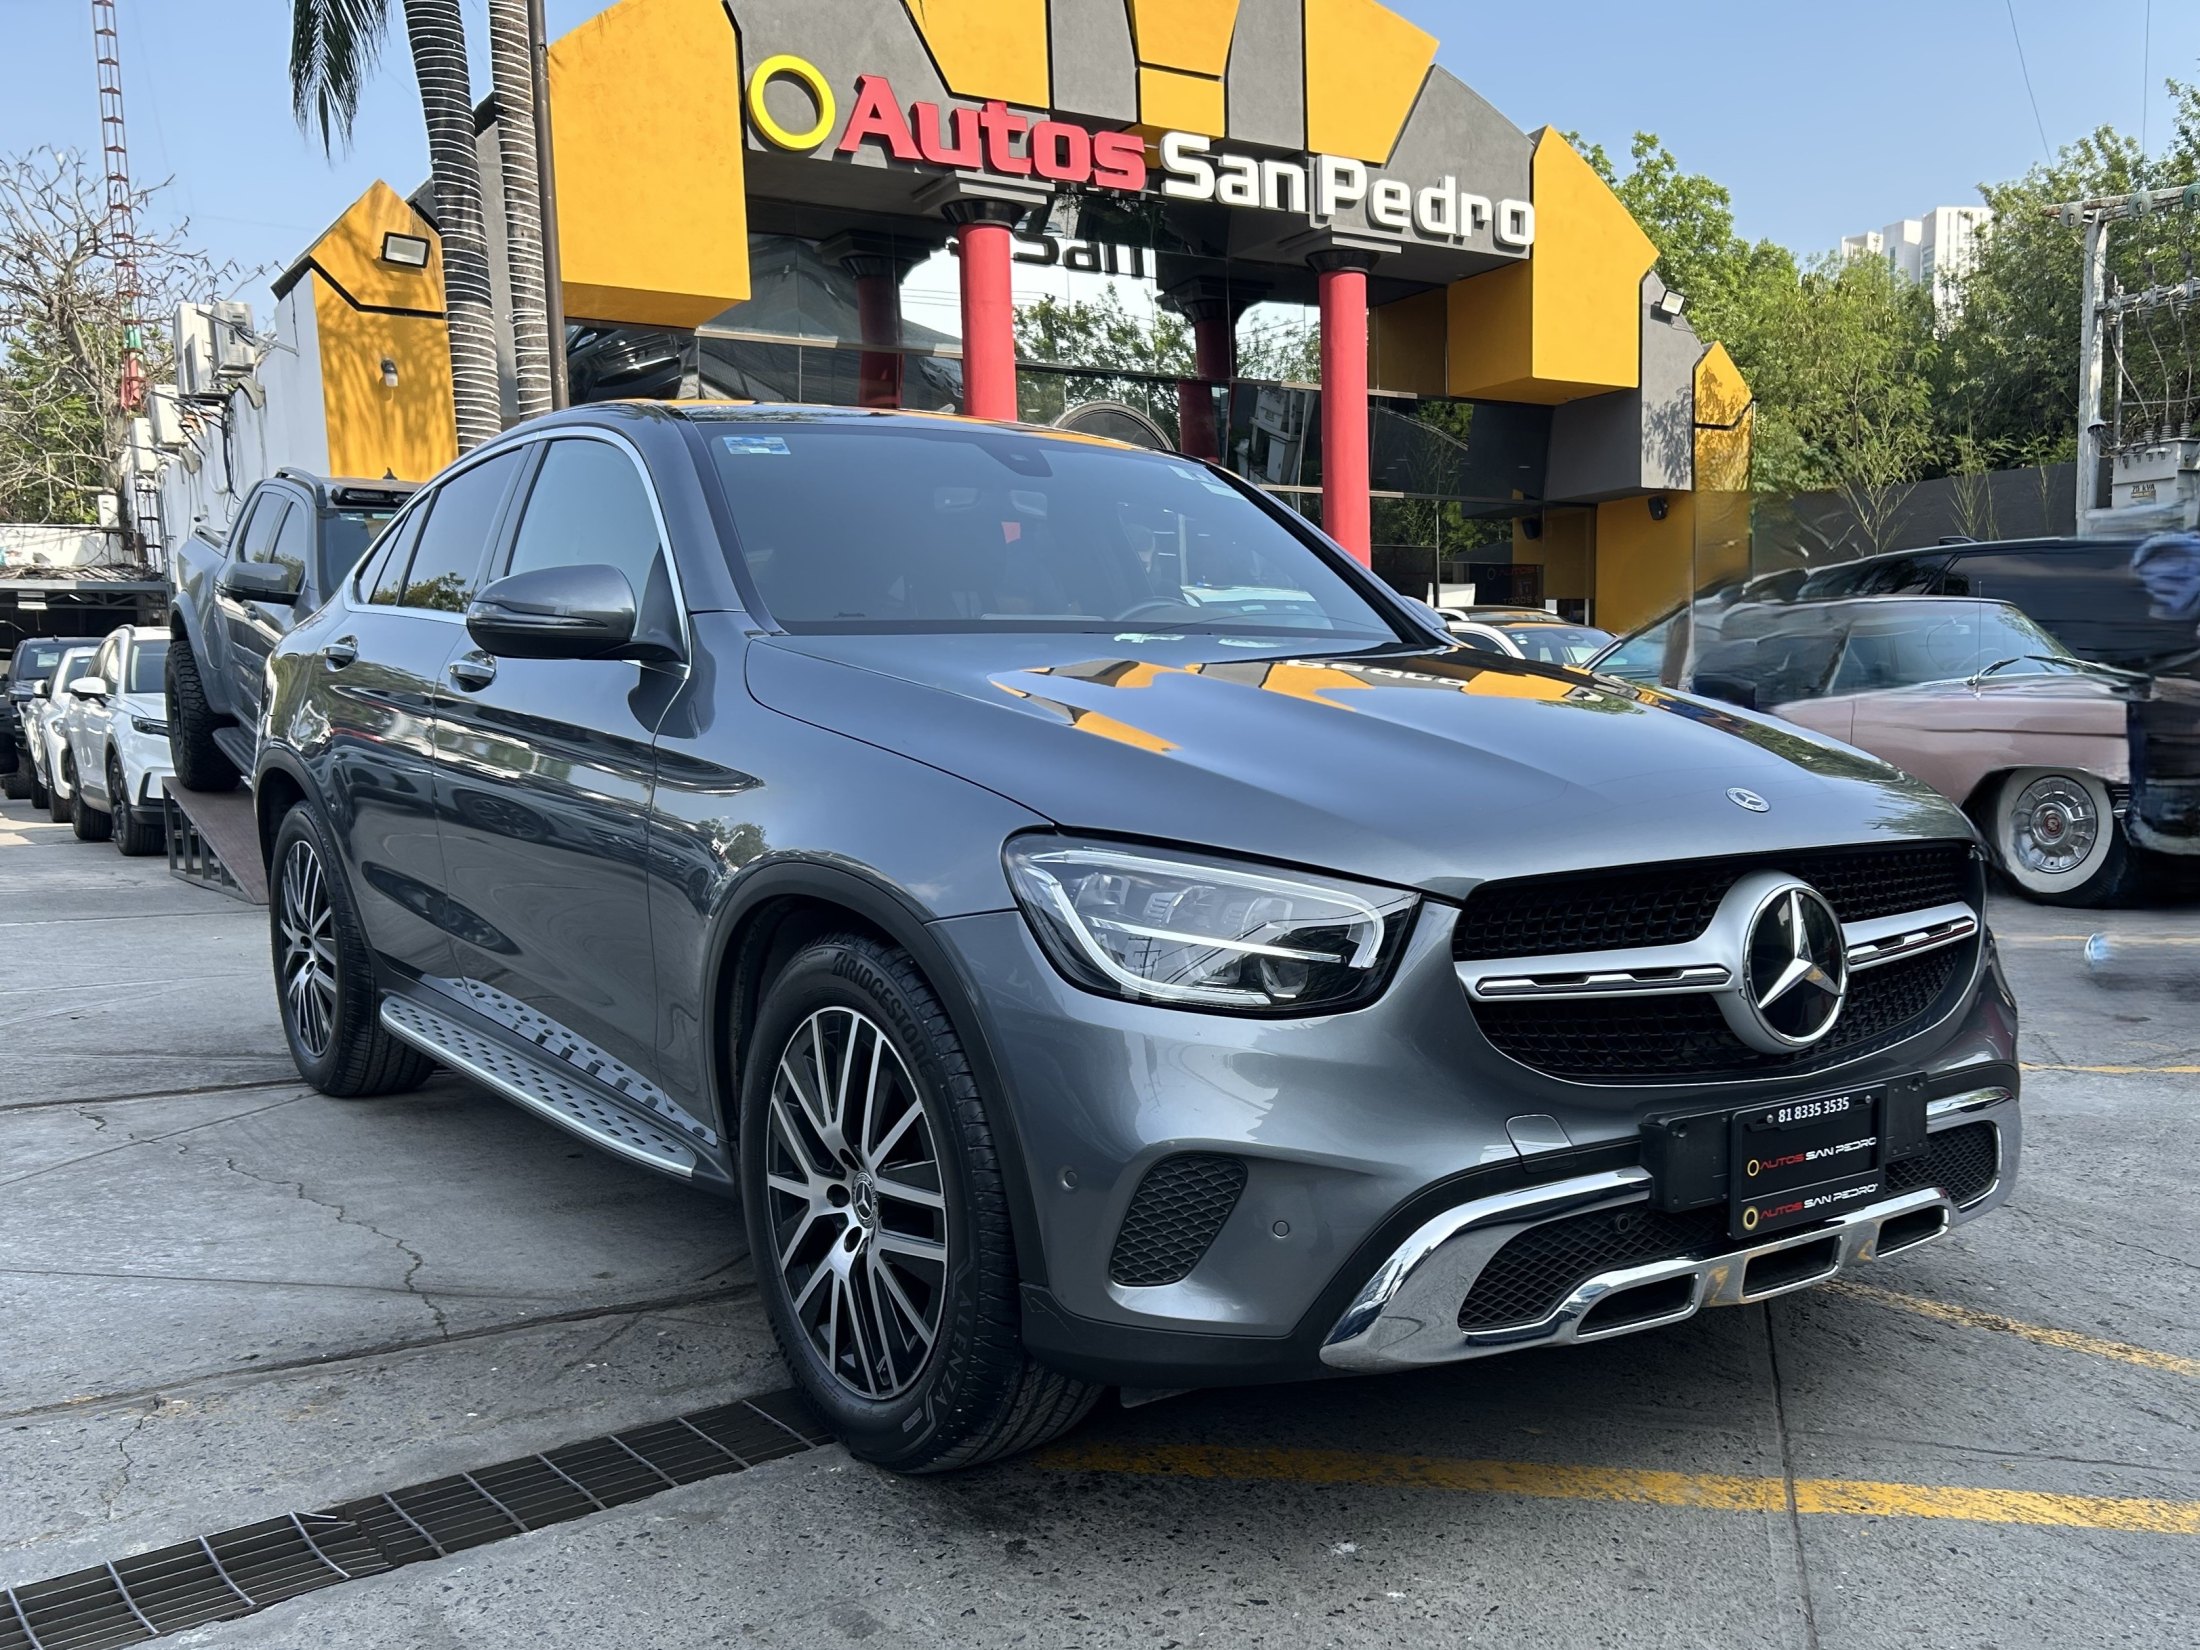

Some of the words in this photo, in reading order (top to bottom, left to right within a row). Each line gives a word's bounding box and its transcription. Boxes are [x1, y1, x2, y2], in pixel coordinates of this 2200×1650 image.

[838, 75, 1147, 192] Autos
[1160, 131, 1306, 211] San
[1322, 156, 1535, 246] Pedro
[832, 951, 936, 1079] BRIDGESTONE
[1778, 1108, 1793, 1123] 81
[1794, 1102, 1822, 1120] 8335
[1823, 1097, 1850, 1115] 3535
[1760, 1153, 1805, 1170] AUTOS
[1805, 1147, 1834, 1161] SAN
[1835, 1136, 1877, 1154] PEDRO
[1760, 1201, 1803, 1220] AUTOS
[1804, 1194, 1832, 1209] SAN
[935, 1289, 973, 1406] ALENZA
